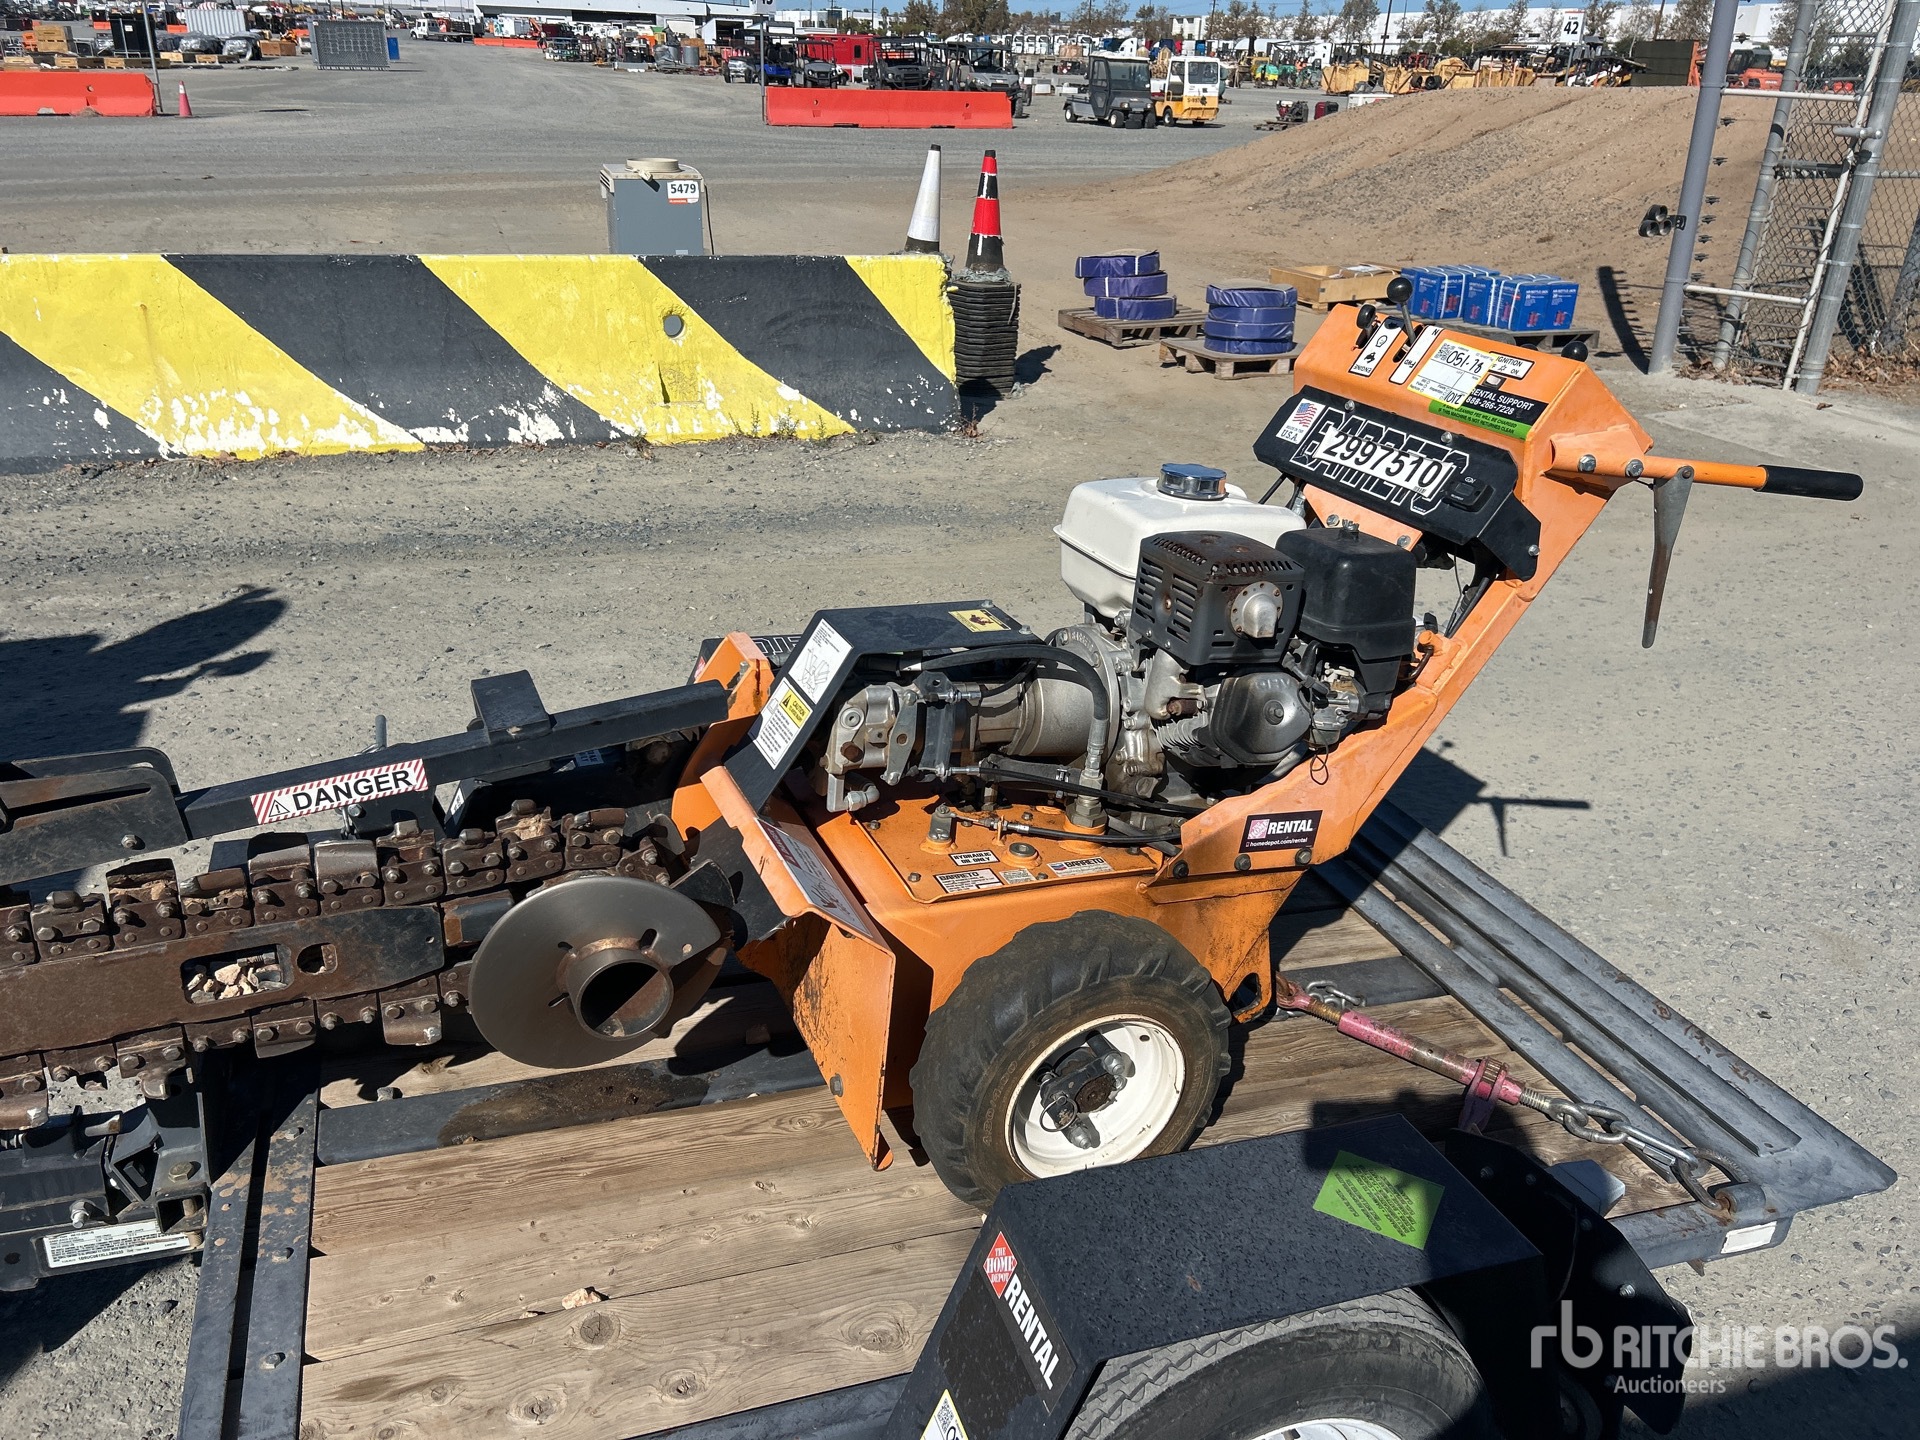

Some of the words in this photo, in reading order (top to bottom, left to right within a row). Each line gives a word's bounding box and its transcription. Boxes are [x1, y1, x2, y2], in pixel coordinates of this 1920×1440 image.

[1563, 21, 1579, 34] 42
[670, 183, 696, 194] 5479
[1495, 356, 1523, 367] IGNITION
[1498, 396, 1534, 411] SUPPORT
[1323, 432, 1443, 488] 2997510
[292, 770, 413, 811] DANGER
[1267, 819, 1313, 835] RENTAL
[953, 852, 992, 861] HYDRAULIC
[1064, 858, 1105, 868] BARRETO
[939, 872, 979, 881] BARRETO
[994, 1247, 1006, 1256] THE
[986, 1257, 1015, 1273] HOME
[990, 1273, 1009, 1283] DEPOT
[1004, 1273, 1060, 1390] RENTAL
